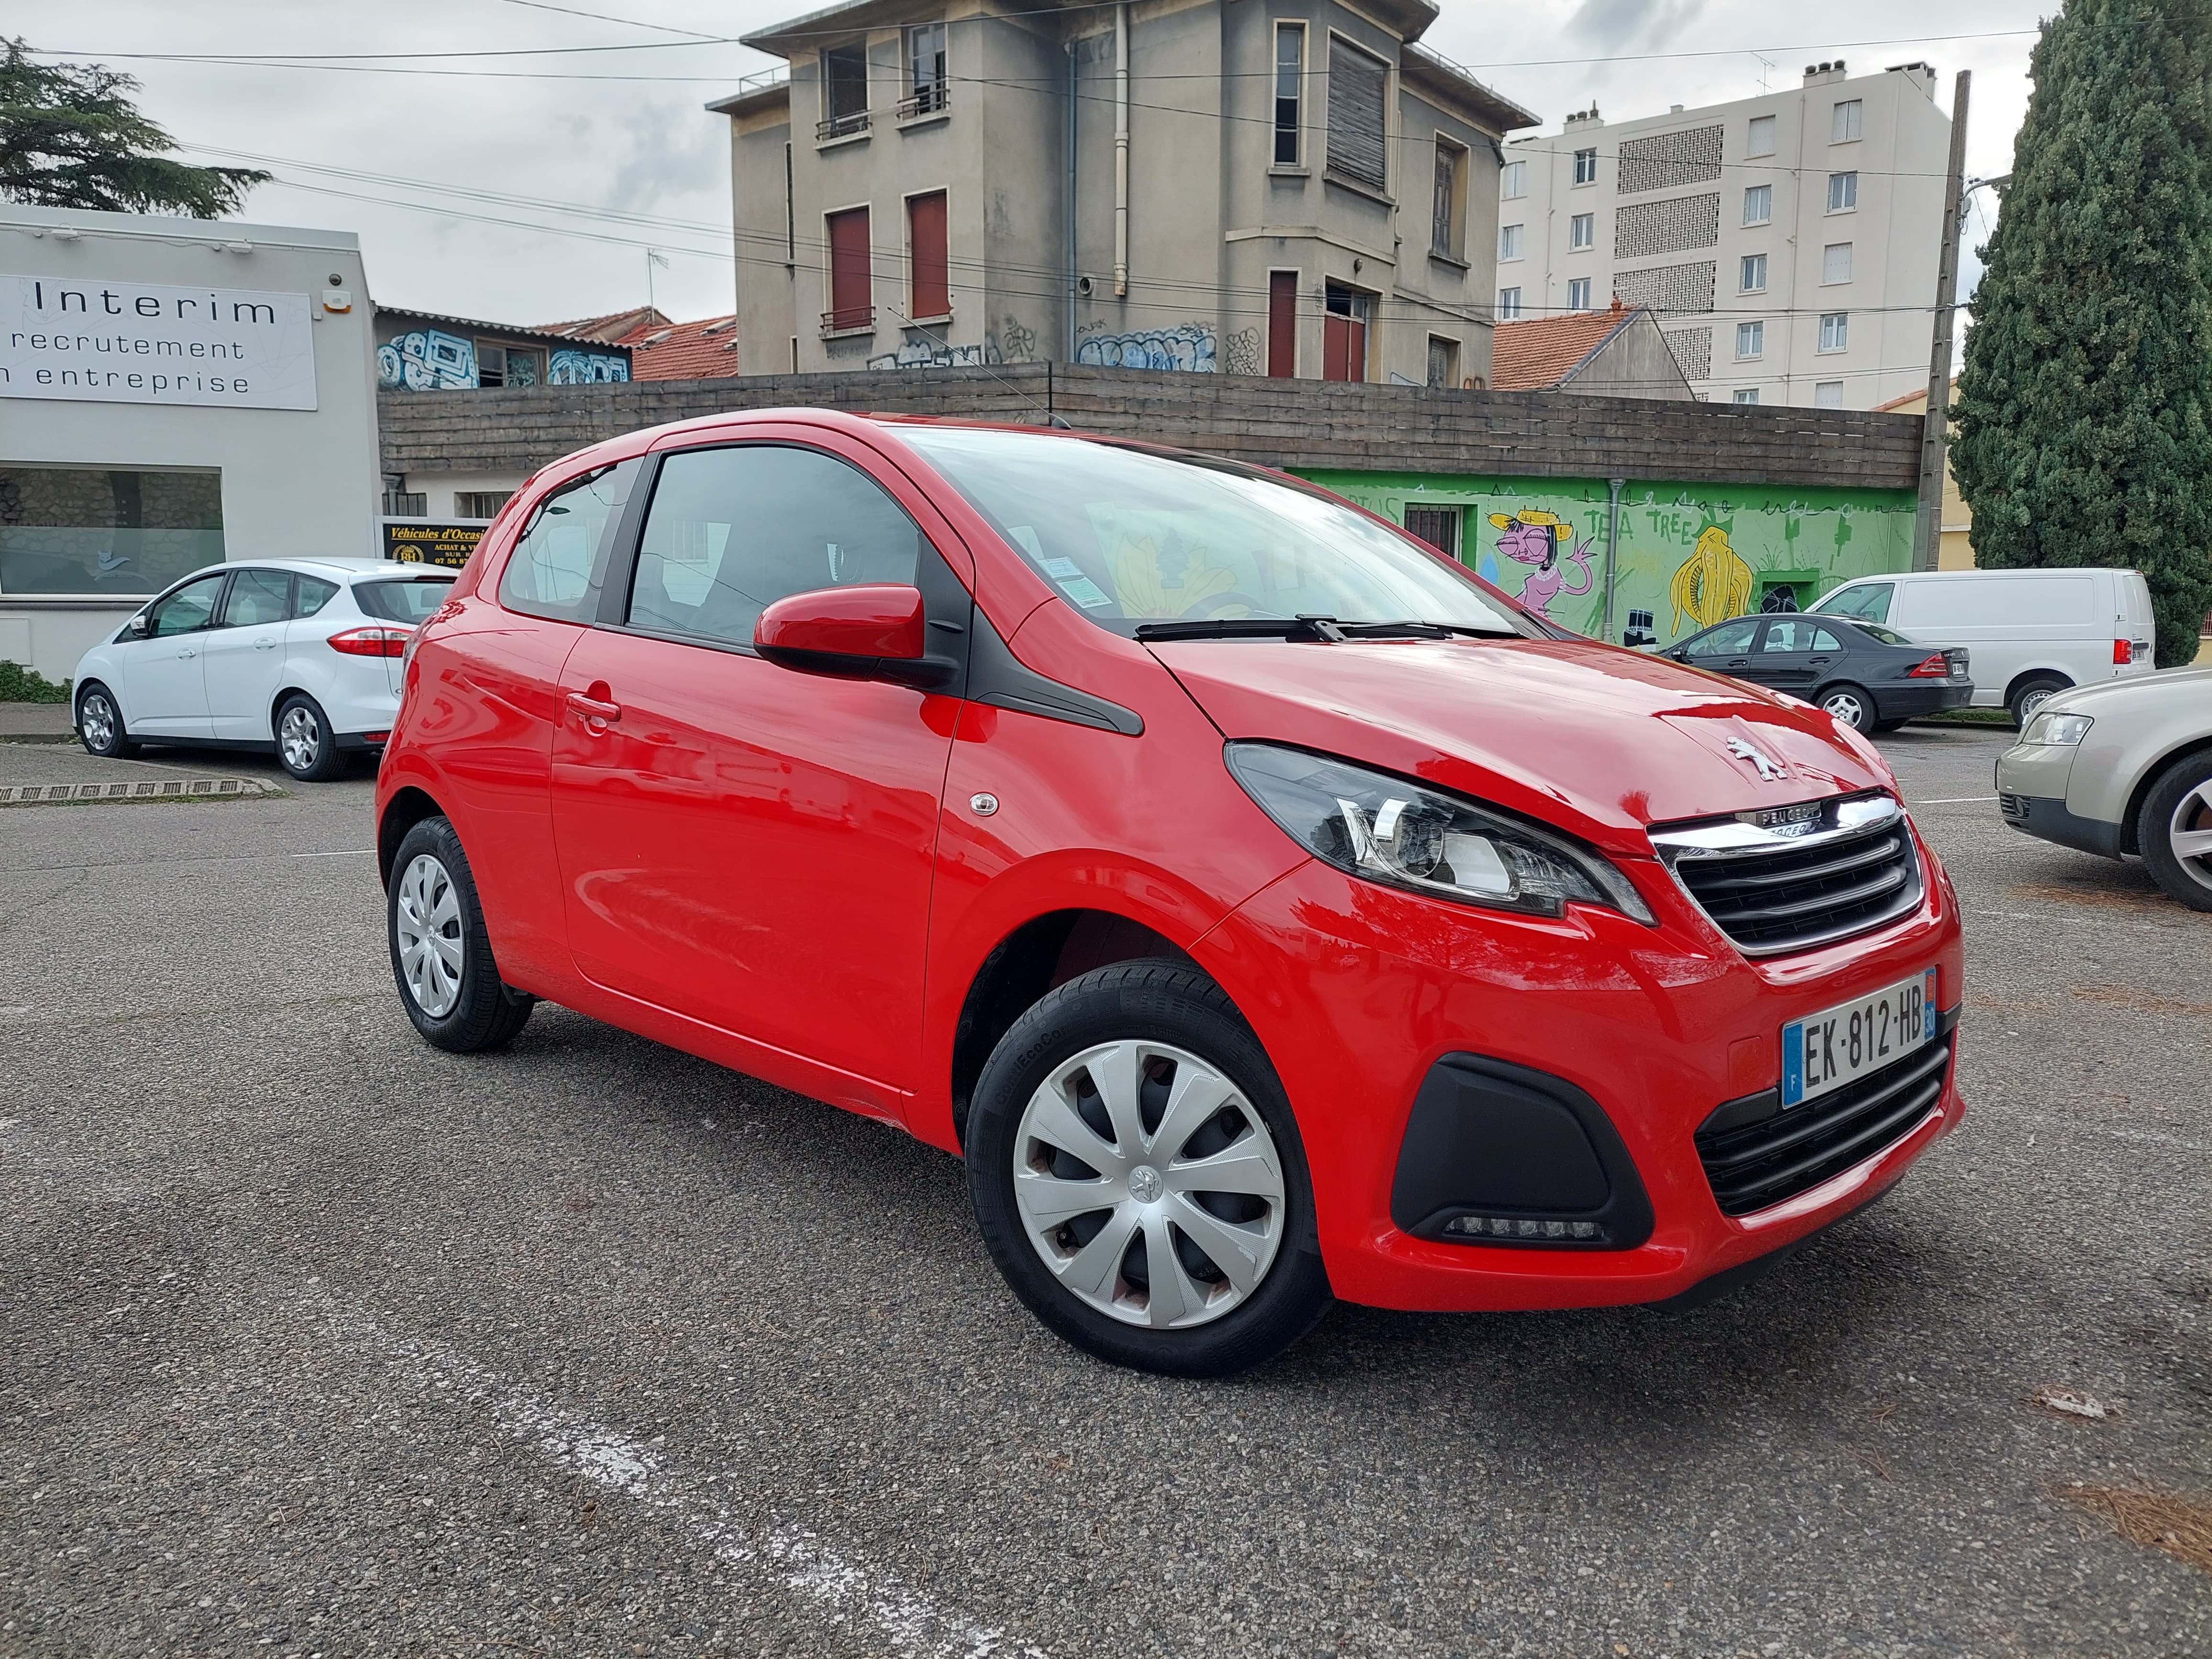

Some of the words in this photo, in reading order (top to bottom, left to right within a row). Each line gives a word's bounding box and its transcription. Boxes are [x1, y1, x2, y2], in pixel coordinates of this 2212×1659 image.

[35, 282, 275, 324] Interim
[12, 332, 244, 359] recrutement
[36, 368, 248, 394] entreprise
[391, 527, 439, 539] Véhicules
[442, 528, 485, 540] d'Occasi
[1583, 509, 1634, 542] TEA
[1646, 509, 1692, 545] TREE
[401, 553, 416, 561] RH
[1762, 806, 1816, 825] PEUGEOT
[1806, 984, 1921, 1089] EK-812-HB
[1791, 1074, 1797, 1092] F
